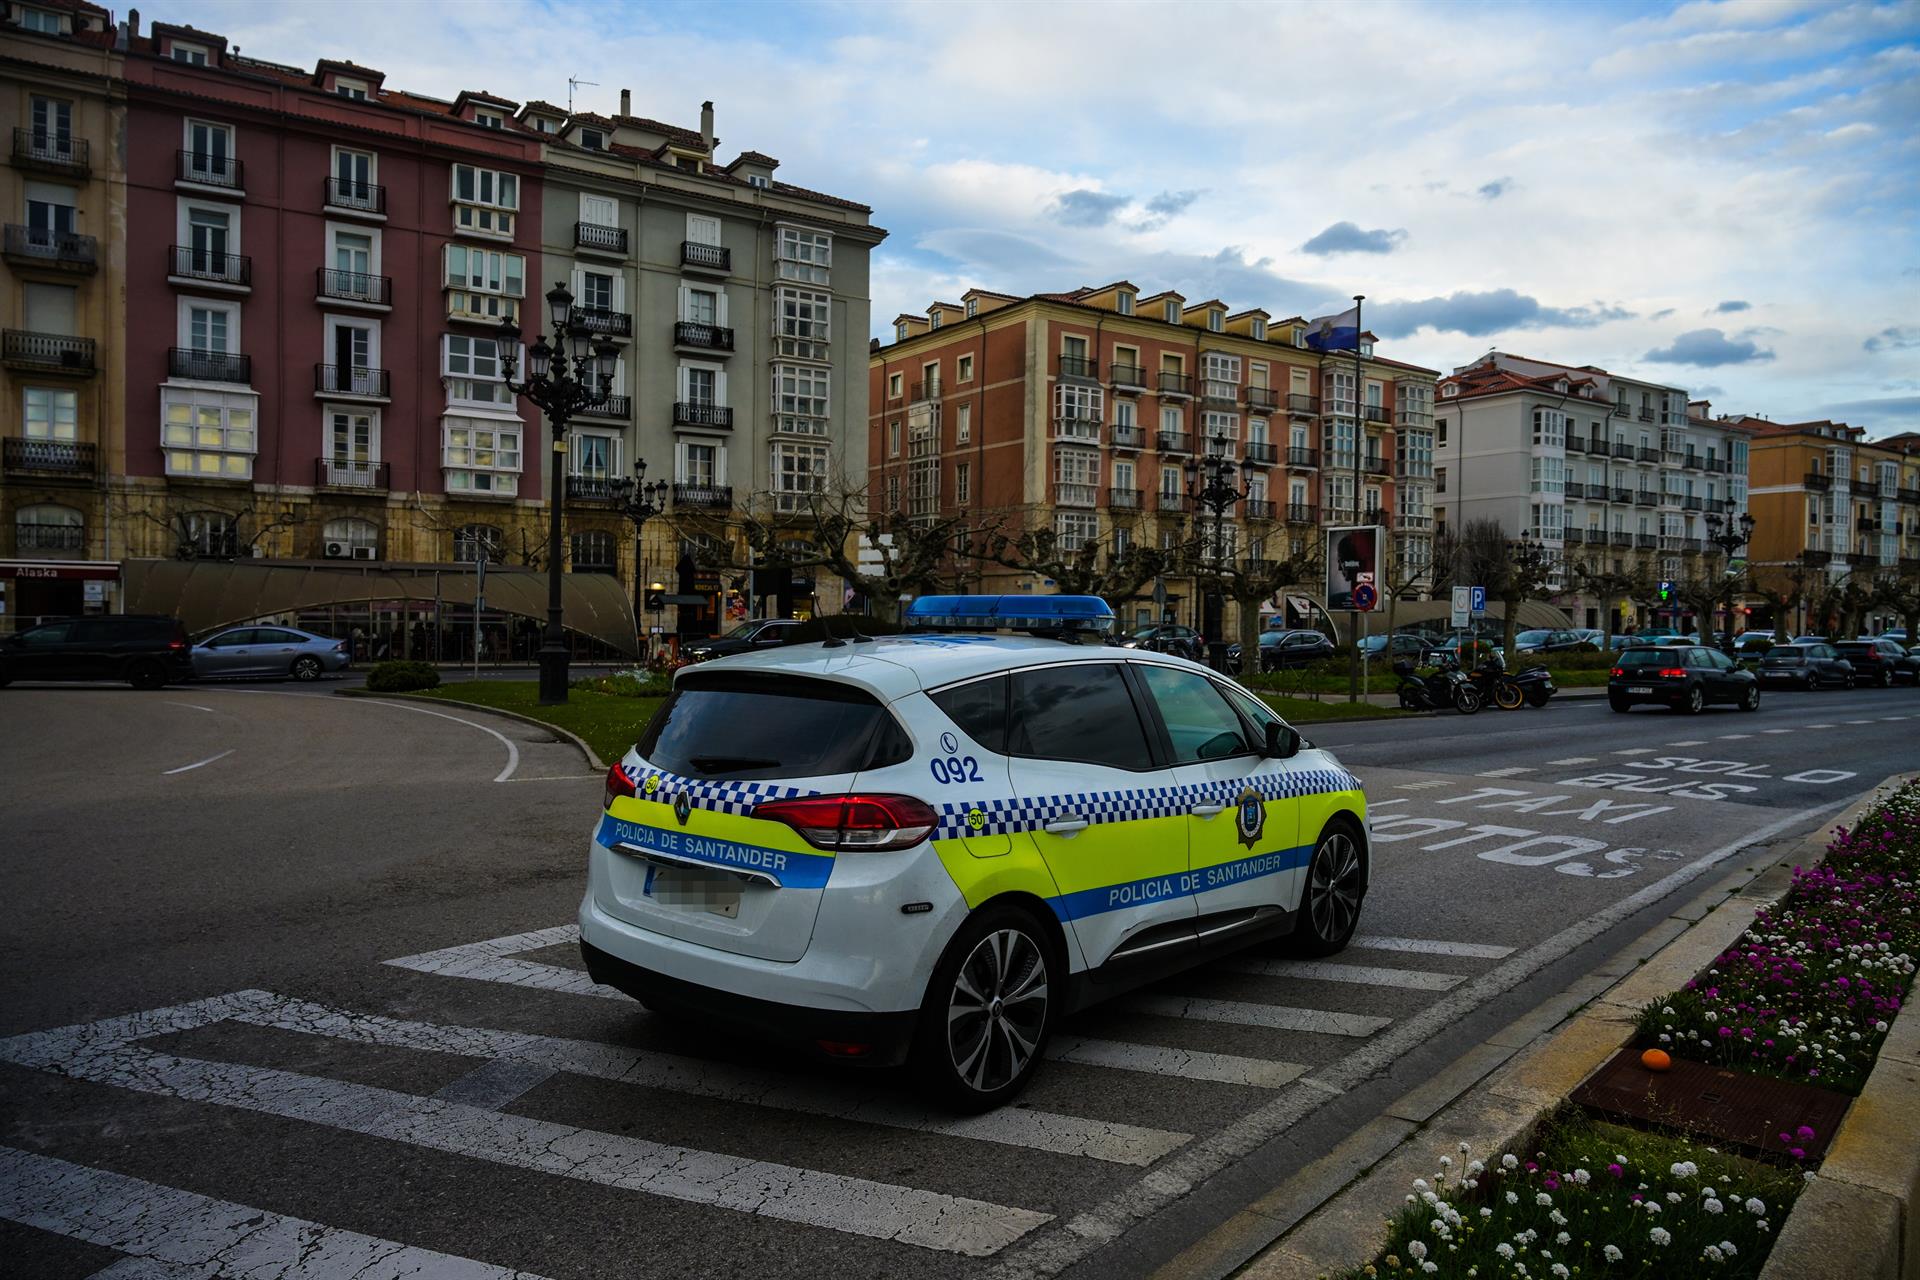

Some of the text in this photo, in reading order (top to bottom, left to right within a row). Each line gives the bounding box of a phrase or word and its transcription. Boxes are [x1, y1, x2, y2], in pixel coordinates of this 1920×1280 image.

[16, 567, 58, 578] Alaska
[1474, 590, 1483, 609] P
[930, 756, 985, 784] 092
[1624, 757, 1858, 784] SOLO
[1555, 773, 1757, 800] BUS
[970, 813, 983, 825] 50
[1434, 787, 1676, 824] TAXI
[615, 822, 787, 871] POLICIA DE SANTANDER
[1109, 855, 1281, 907] POLICIA DE SANTANDER
